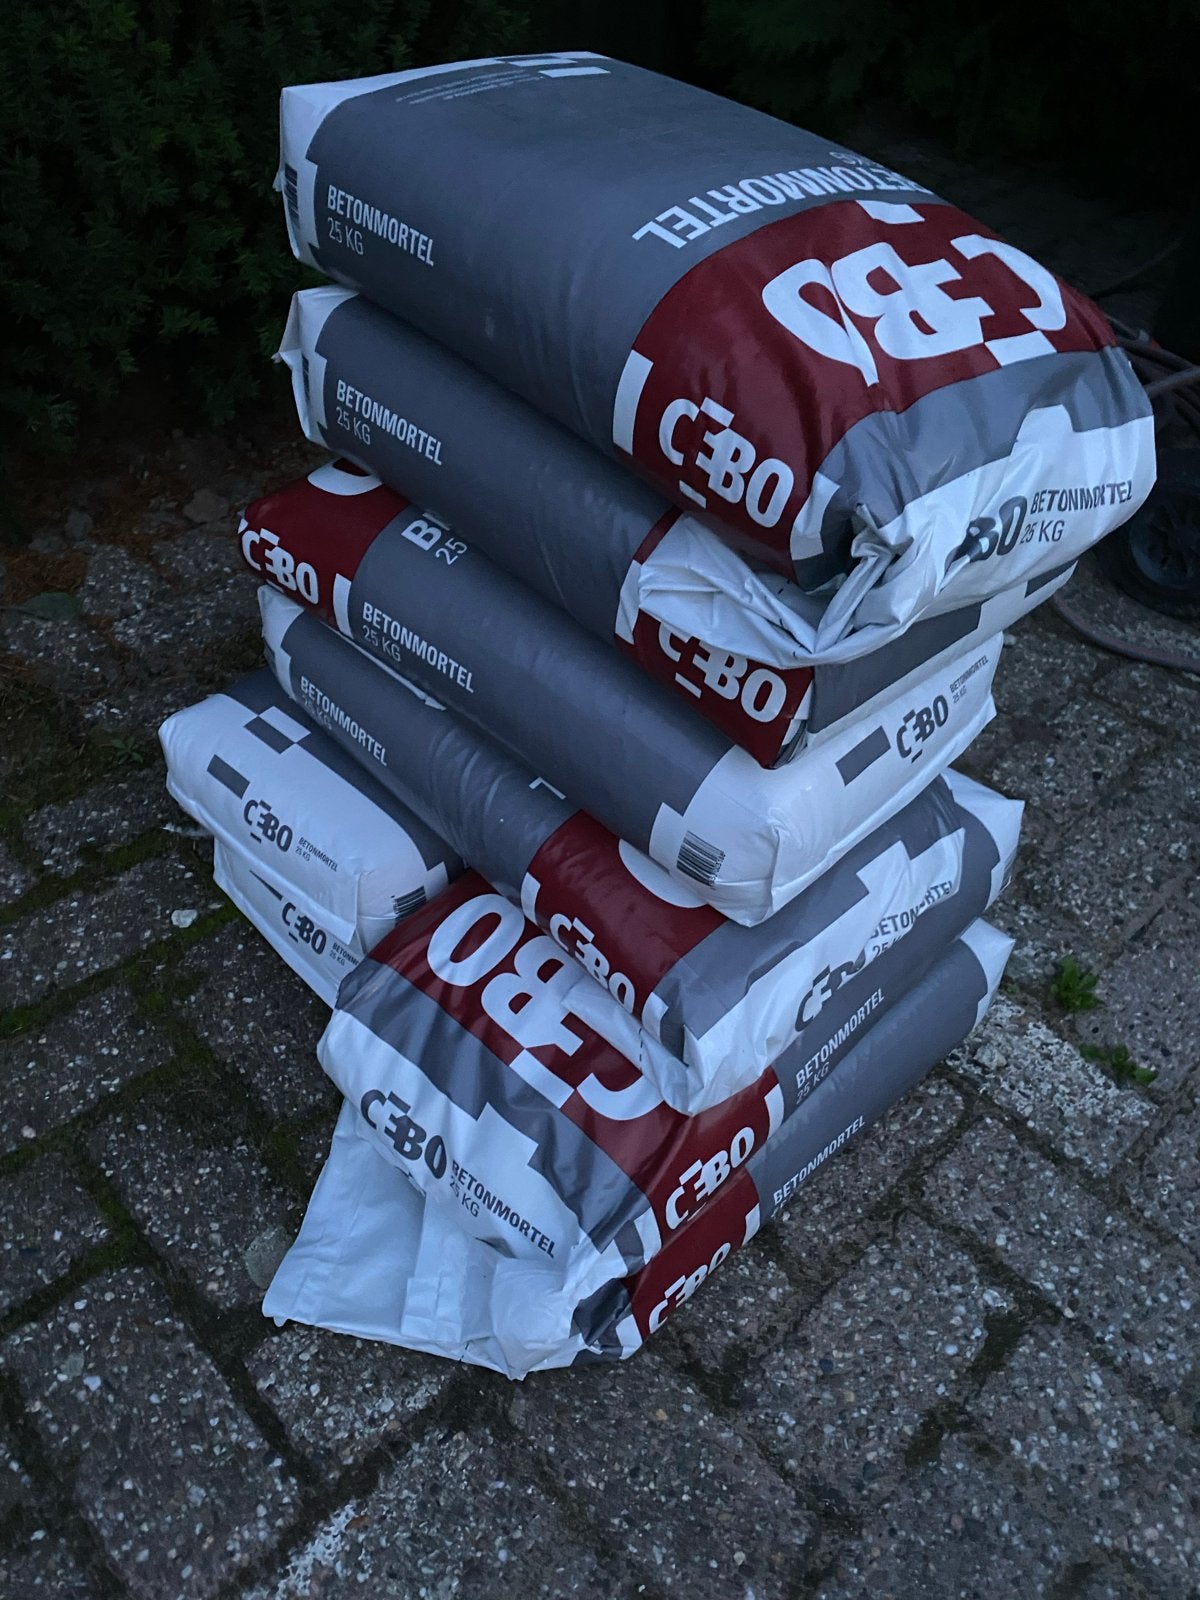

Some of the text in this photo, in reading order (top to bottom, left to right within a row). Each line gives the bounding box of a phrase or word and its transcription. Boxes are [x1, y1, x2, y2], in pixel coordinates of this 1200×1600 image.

[327, 185, 434, 266] BETONMORTEL
[327, 217, 364, 256] 25 KG
[632, 167, 934, 249] ETONMORTEL
[336, 380, 442, 466] BETONMORTEL
[336, 407, 371, 445] 25 KG
[659, 397, 794, 528] CEBO
[241, 527, 319, 605] CEBO
[435, 538, 467, 565] 25
[1020, 520, 1065, 545] 25 KG
[362, 625, 401, 663] 25 KG
[362, 602, 474, 693] BETONMORTEL
[300, 675, 387, 767] BETONMORTEL
[896, 695, 949, 764] CEBO
[243, 800, 293, 853] CEBO
[298, 837, 338, 872] BETONMORTEL
[795, 988, 885, 1088] BETONMORTEL
[813, 1062, 830, 1084] KG
[361, 1089, 447, 1180] CEBO
[773, 1115, 866, 1206] BETONMORTEL
[451, 1159, 556, 1259] BETONMORTEL
[461, 1196, 480, 1218] KG
[665, 1126, 755, 1230] CEBO
